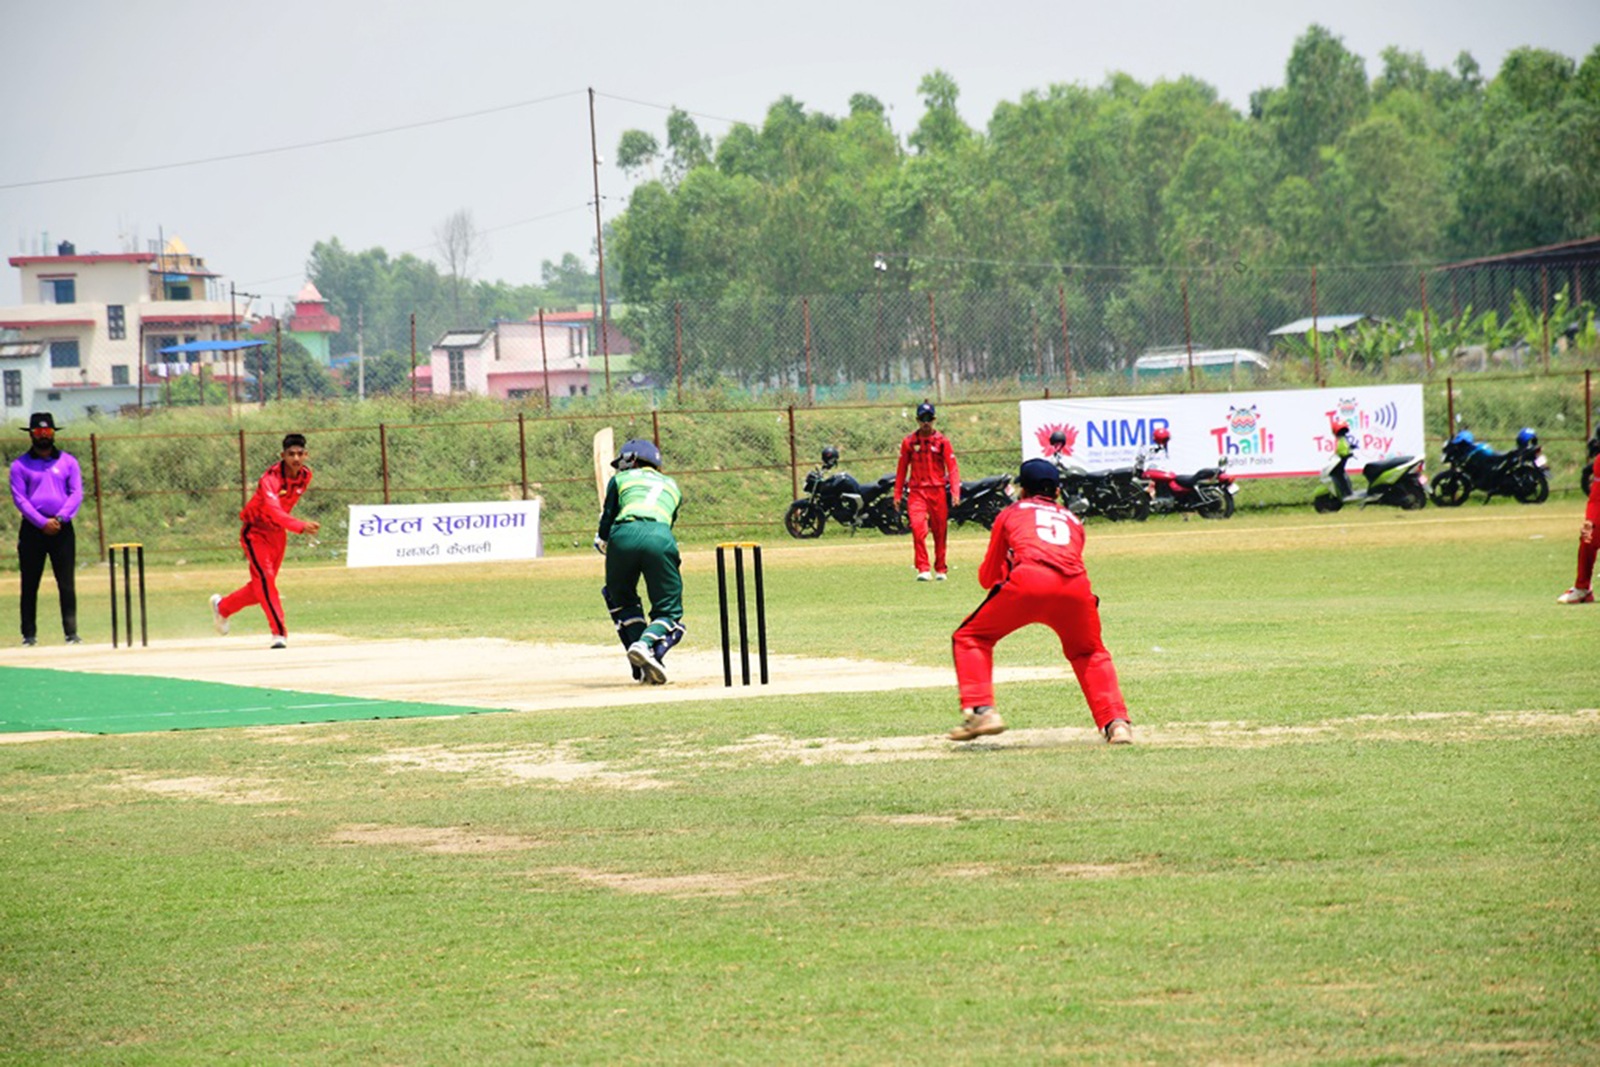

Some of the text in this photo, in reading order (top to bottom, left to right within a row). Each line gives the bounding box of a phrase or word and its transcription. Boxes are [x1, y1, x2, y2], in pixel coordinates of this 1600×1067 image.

[1325, 410, 1370, 430] Taili
[1210, 426, 1274, 456] Thaili
[1363, 434, 1393, 453] Pay
[1222, 457, 1247, 467] gital
[643, 479, 665, 507] 7
[359, 514, 424, 536] होटल
[1035, 508, 1070, 546] 5
